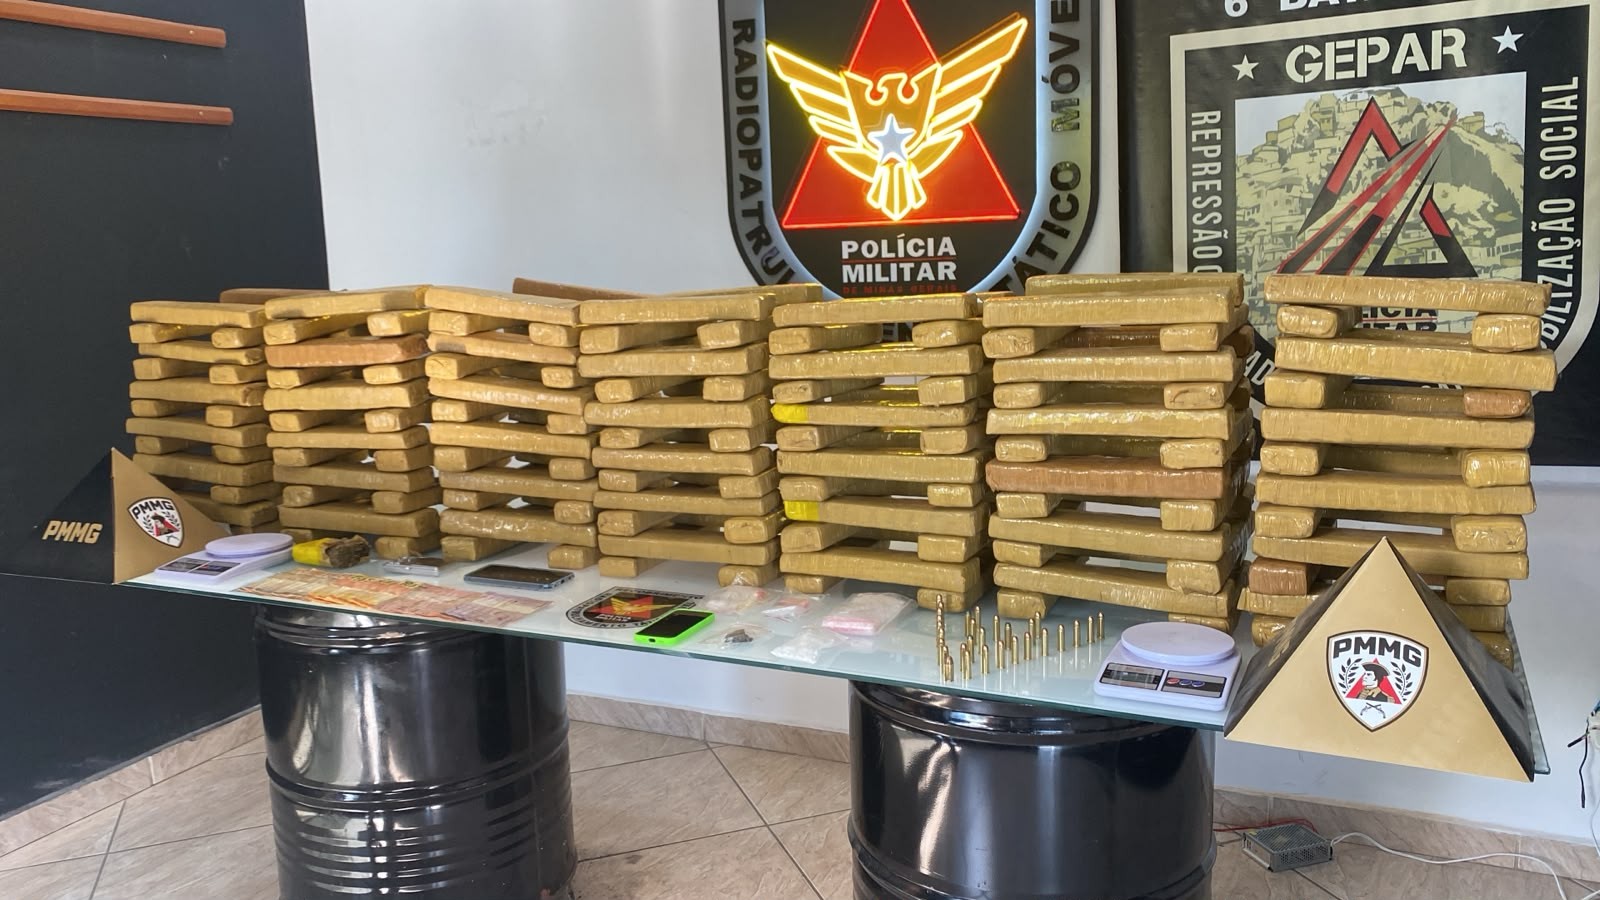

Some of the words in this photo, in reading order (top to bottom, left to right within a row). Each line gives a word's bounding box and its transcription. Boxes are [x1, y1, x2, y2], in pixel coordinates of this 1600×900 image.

[1285, 28, 1467, 83] GEPAR
[1540, 76, 1578, 180] SOCIAL
[1191, 110, 1228, 259] REPRESSÃO
[841, 233, 957, 259] POLÍCIA
[842, 261, 957, 283] MILITAR
[842, 286, 858, 295] DE
[863, 285, 903, 294] MINAS
[910, 284, 957, 293] GERAIS
[132, 500, 175, 519] PMMG
[42, 520, 103, 544] PMMG
[1333, 636, 1422, 668] PMMG
